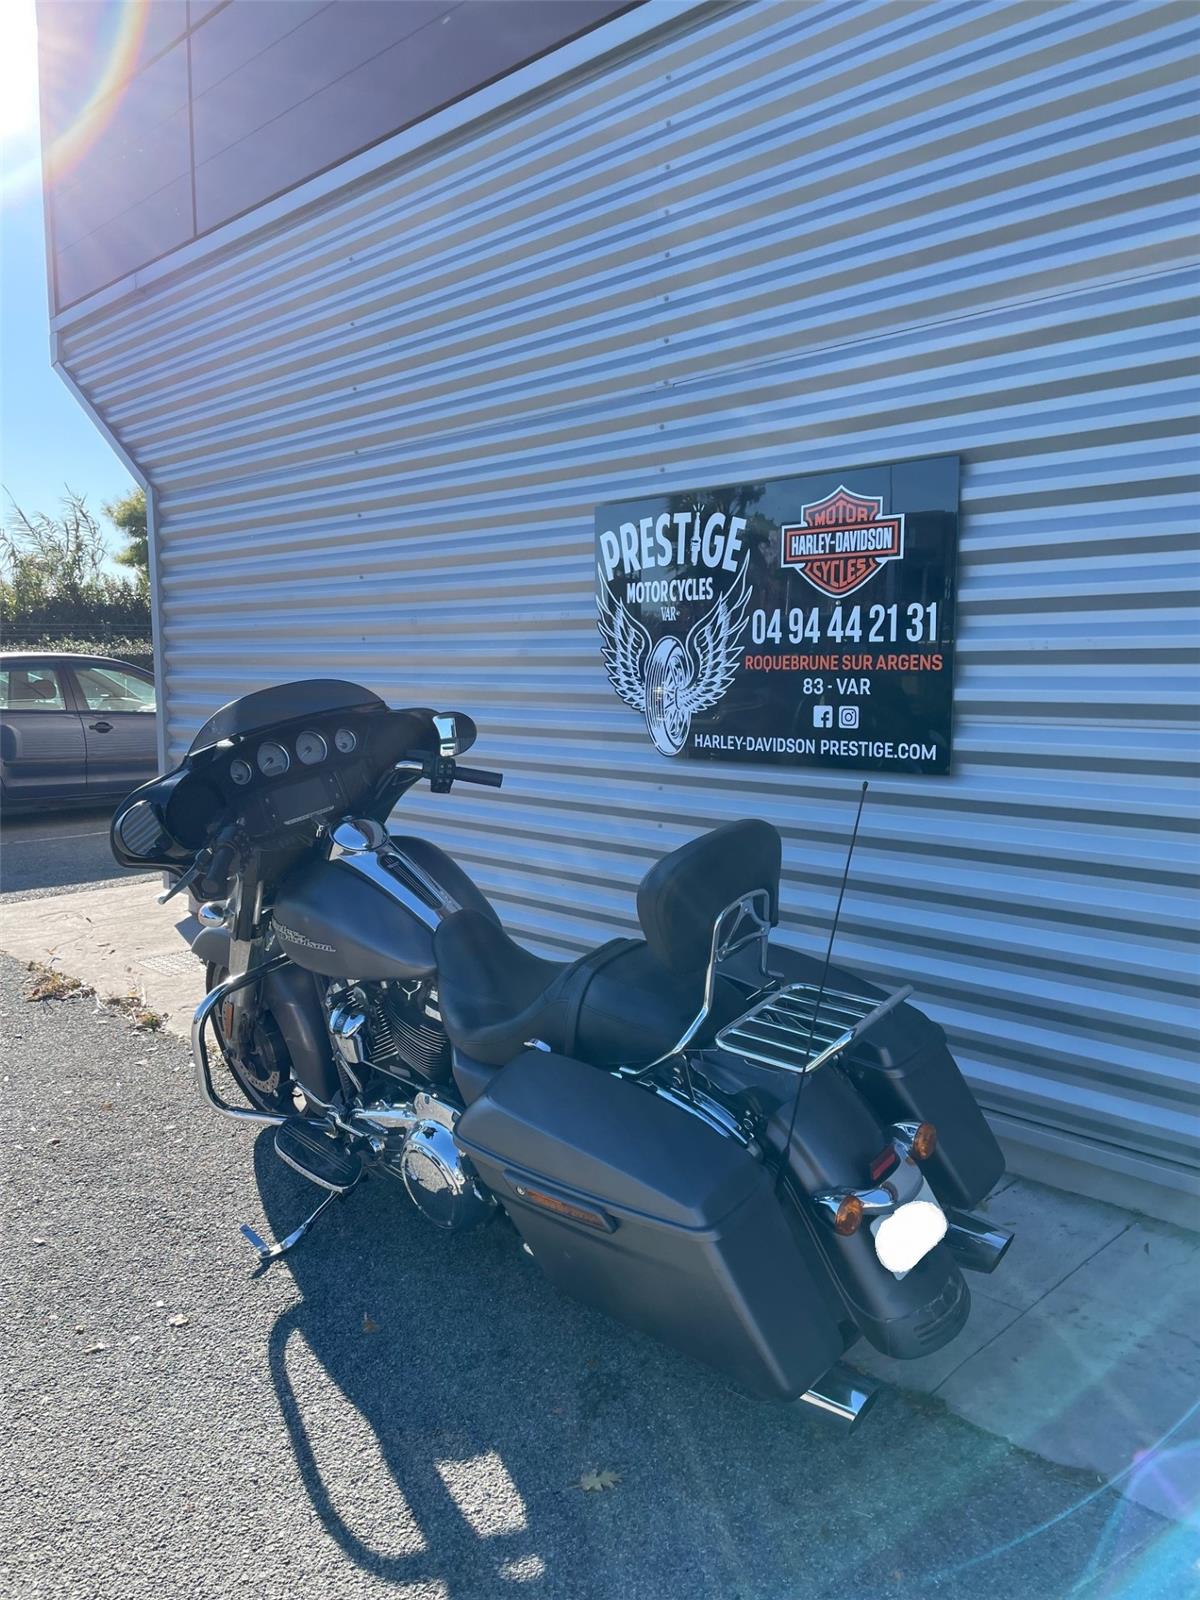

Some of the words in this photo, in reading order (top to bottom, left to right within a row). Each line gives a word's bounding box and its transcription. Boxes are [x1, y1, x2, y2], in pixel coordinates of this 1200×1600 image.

[815, 500, 868, 527] MOTOR
[600, 511, 747, 582] PRESTIGE
[791, 527, 893, 556] HARLEY-DAVIDSON
[812, 558, 866, 587] CYCLES
[626, 577, 714, 604] MOTORCYCLES
[660, 606, 677, 621] VAR
[752, 609, 782, 645] 04
[788, 607, 821, 645] 94
[827, 606, 862, 643] 44
[868, 603, 898, 643] 21
[906, 602, 937, 642] 31
[744, 655, 839, 673] ROQUEBRUNE
[842, 655, 873, 671] SUR
[876, 654, 944, 671] ARGENS
[803, 678, 824, 695] 83
[836, 678, 871, 695] VAR
[694, 734, 815, 755] HARLEY-DAVIDSON
[820, 739, 937, 760] PRESTIGE.COM
